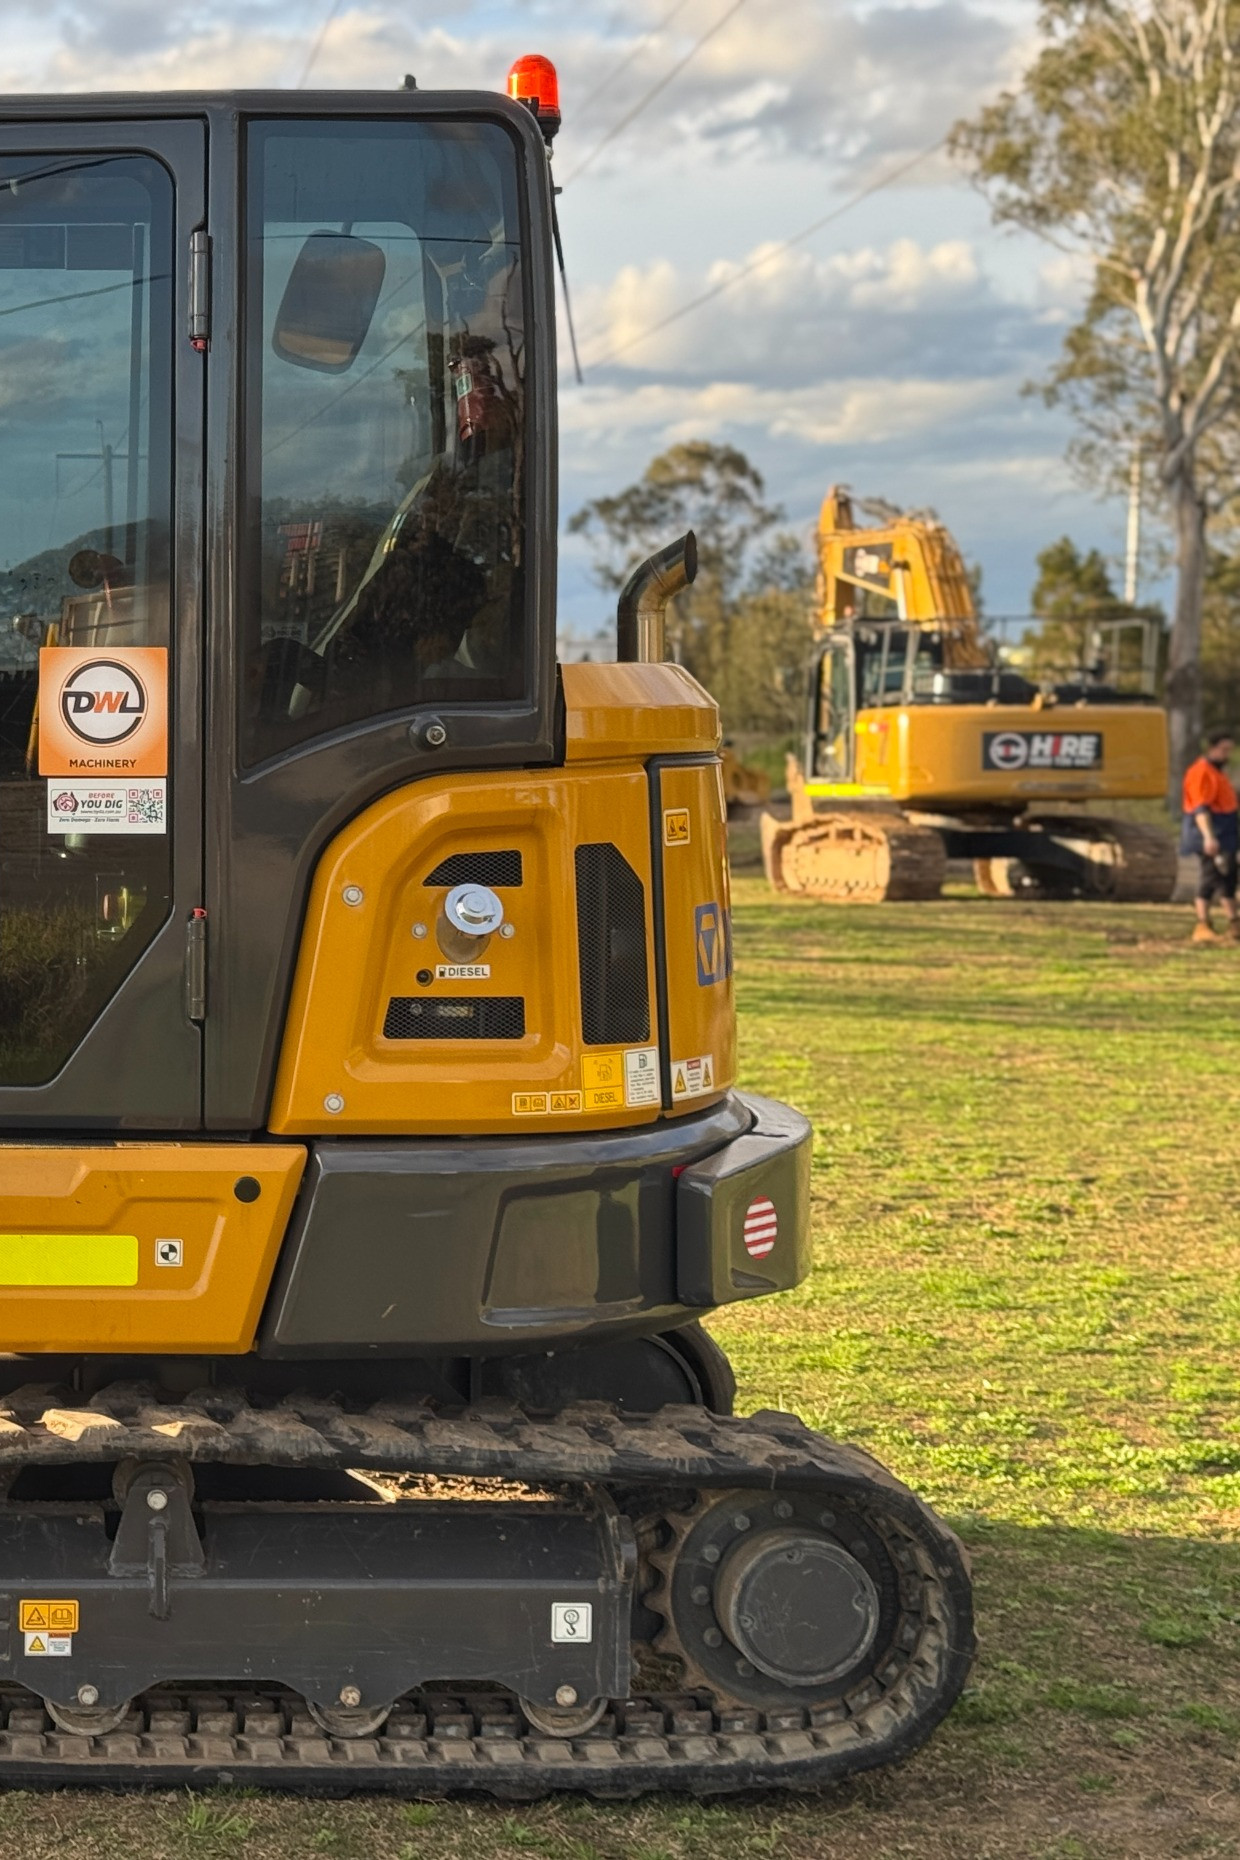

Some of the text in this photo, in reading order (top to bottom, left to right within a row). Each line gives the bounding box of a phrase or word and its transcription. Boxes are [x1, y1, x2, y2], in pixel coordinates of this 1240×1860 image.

[62, 691, 144, 713] DWL
[1030, 734, 1097, 757] HIRE
[69, 759, 137, 768] MACHINERY
[80, 800, 123, 809] YOU DIG
[448, 967, 488, 977] DIESEL
[593, 1092, 618, 1104] DIESEL
